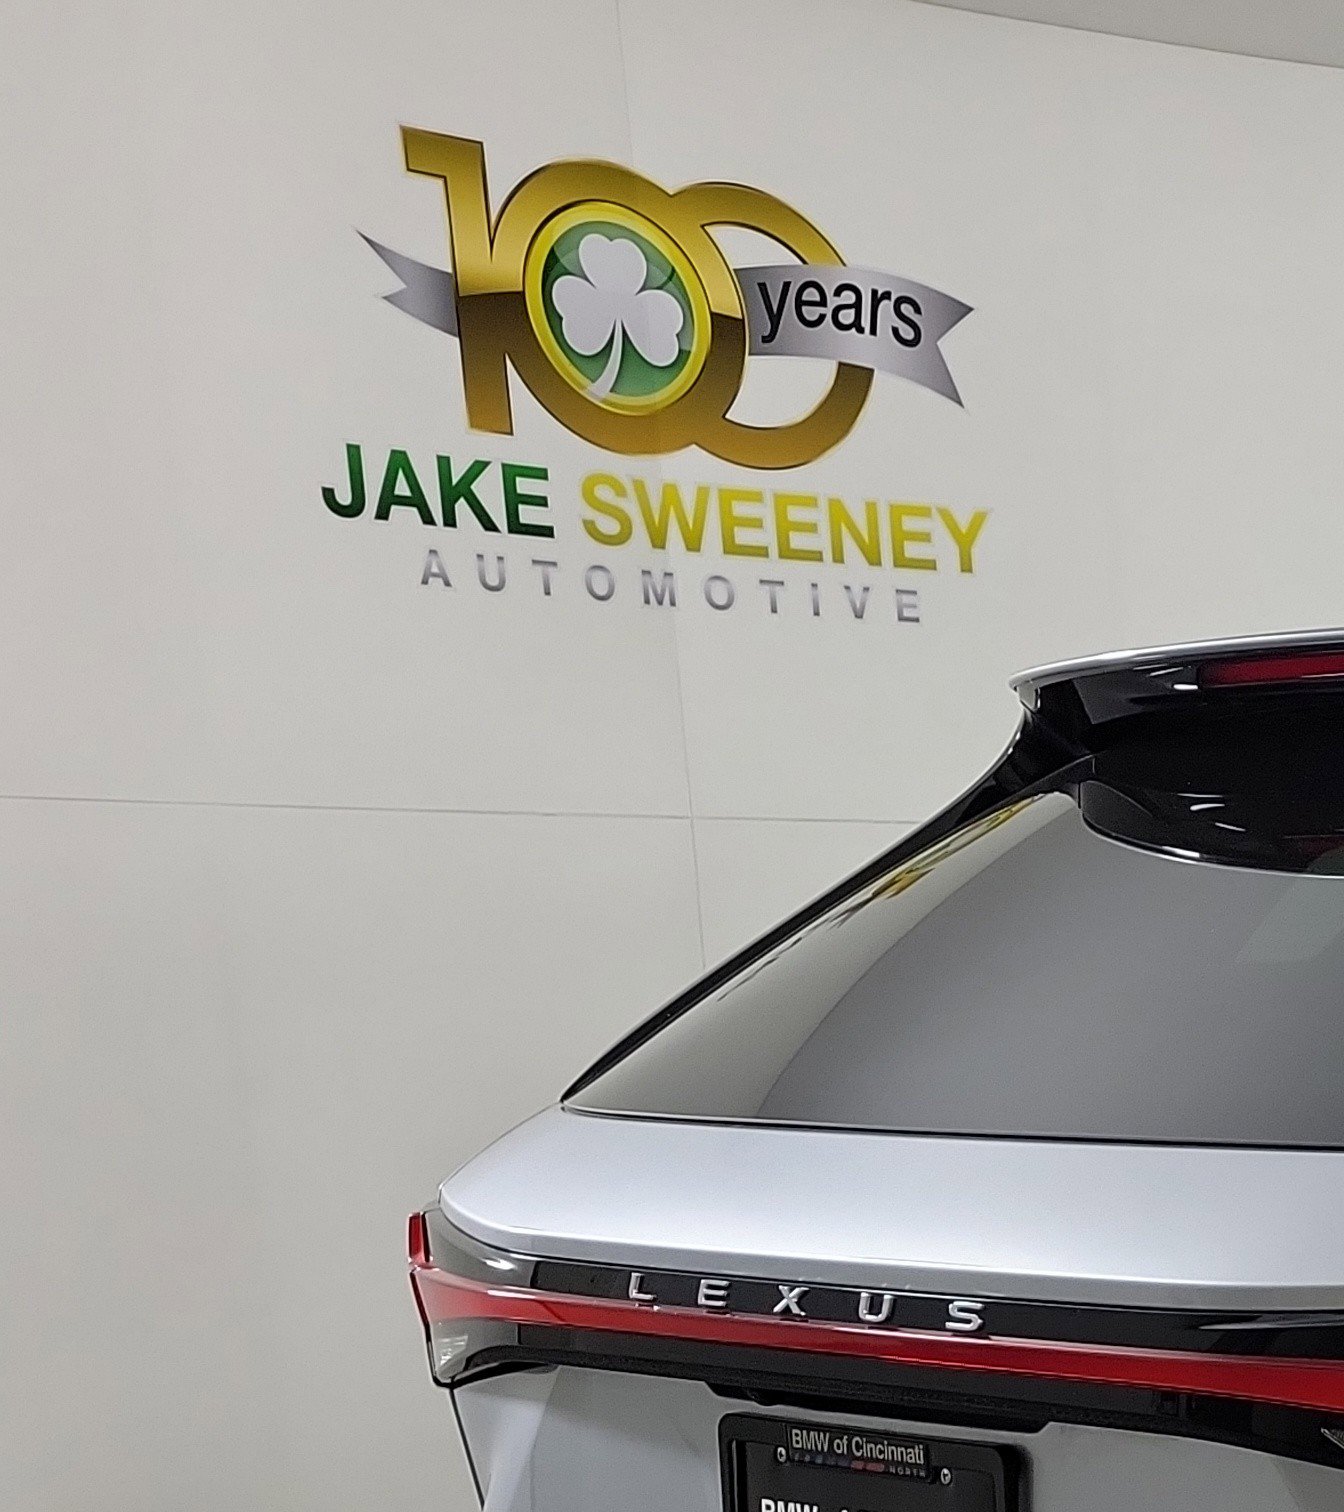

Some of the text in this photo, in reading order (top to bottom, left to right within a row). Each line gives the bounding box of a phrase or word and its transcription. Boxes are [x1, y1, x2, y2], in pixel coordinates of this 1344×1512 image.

[757, 278, 923, 348] years
[320, 443, 990, 574] JAKE SWEENEY
[420, 549, 920, 623] AUTOMOTIVE
[627, 1271, 985, 1333] LEXUS
[791, 1429, 925, 1466] BMW of Cincinnati
